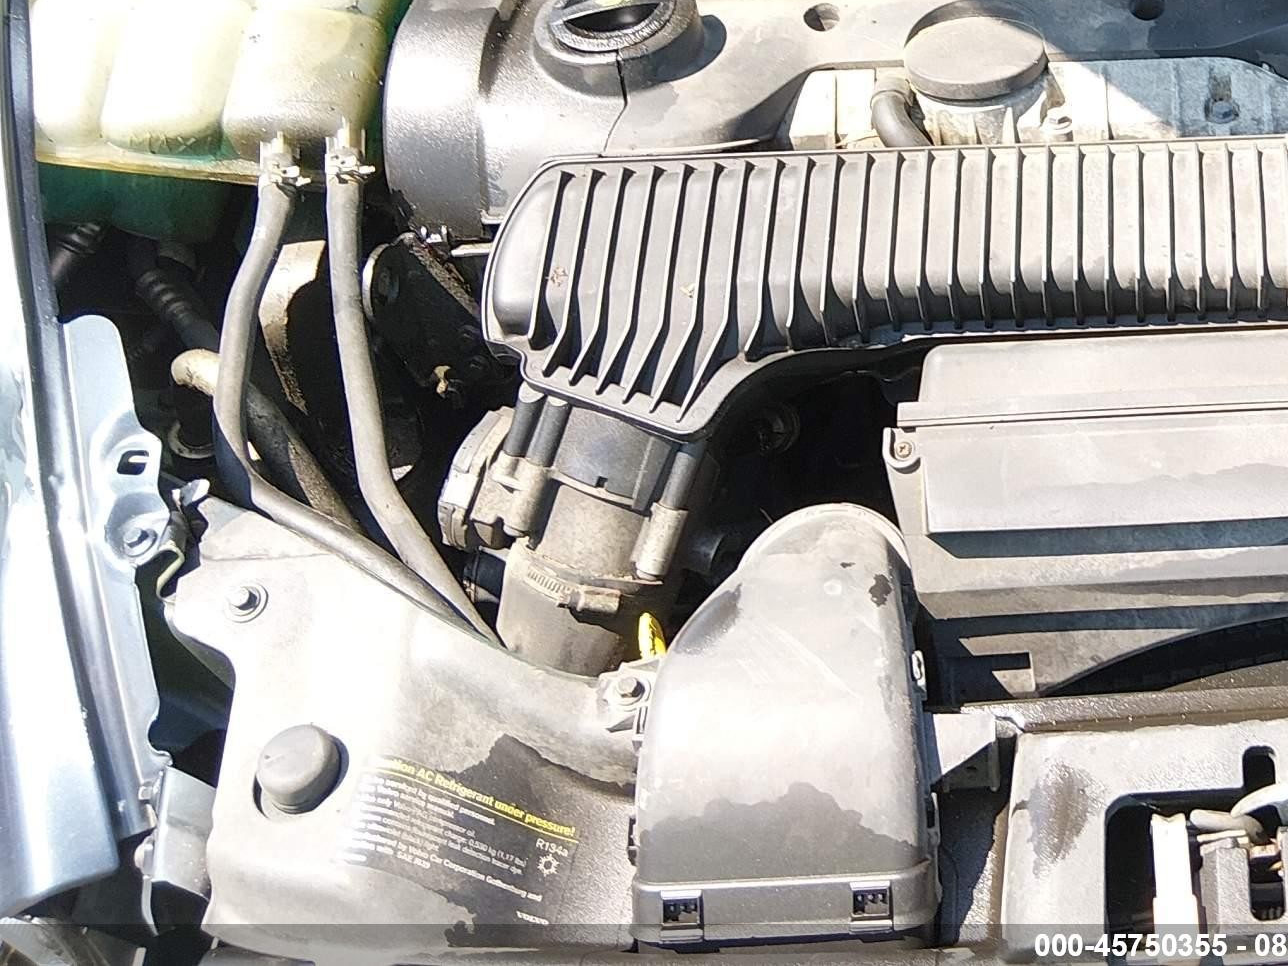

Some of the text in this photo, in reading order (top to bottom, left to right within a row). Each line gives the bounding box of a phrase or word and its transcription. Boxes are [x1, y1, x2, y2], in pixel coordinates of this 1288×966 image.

[416, 767, 435, 783] AC
[434, 772, 495, 807] Refrigerant
[524, 813, 576, 837] pressure!
